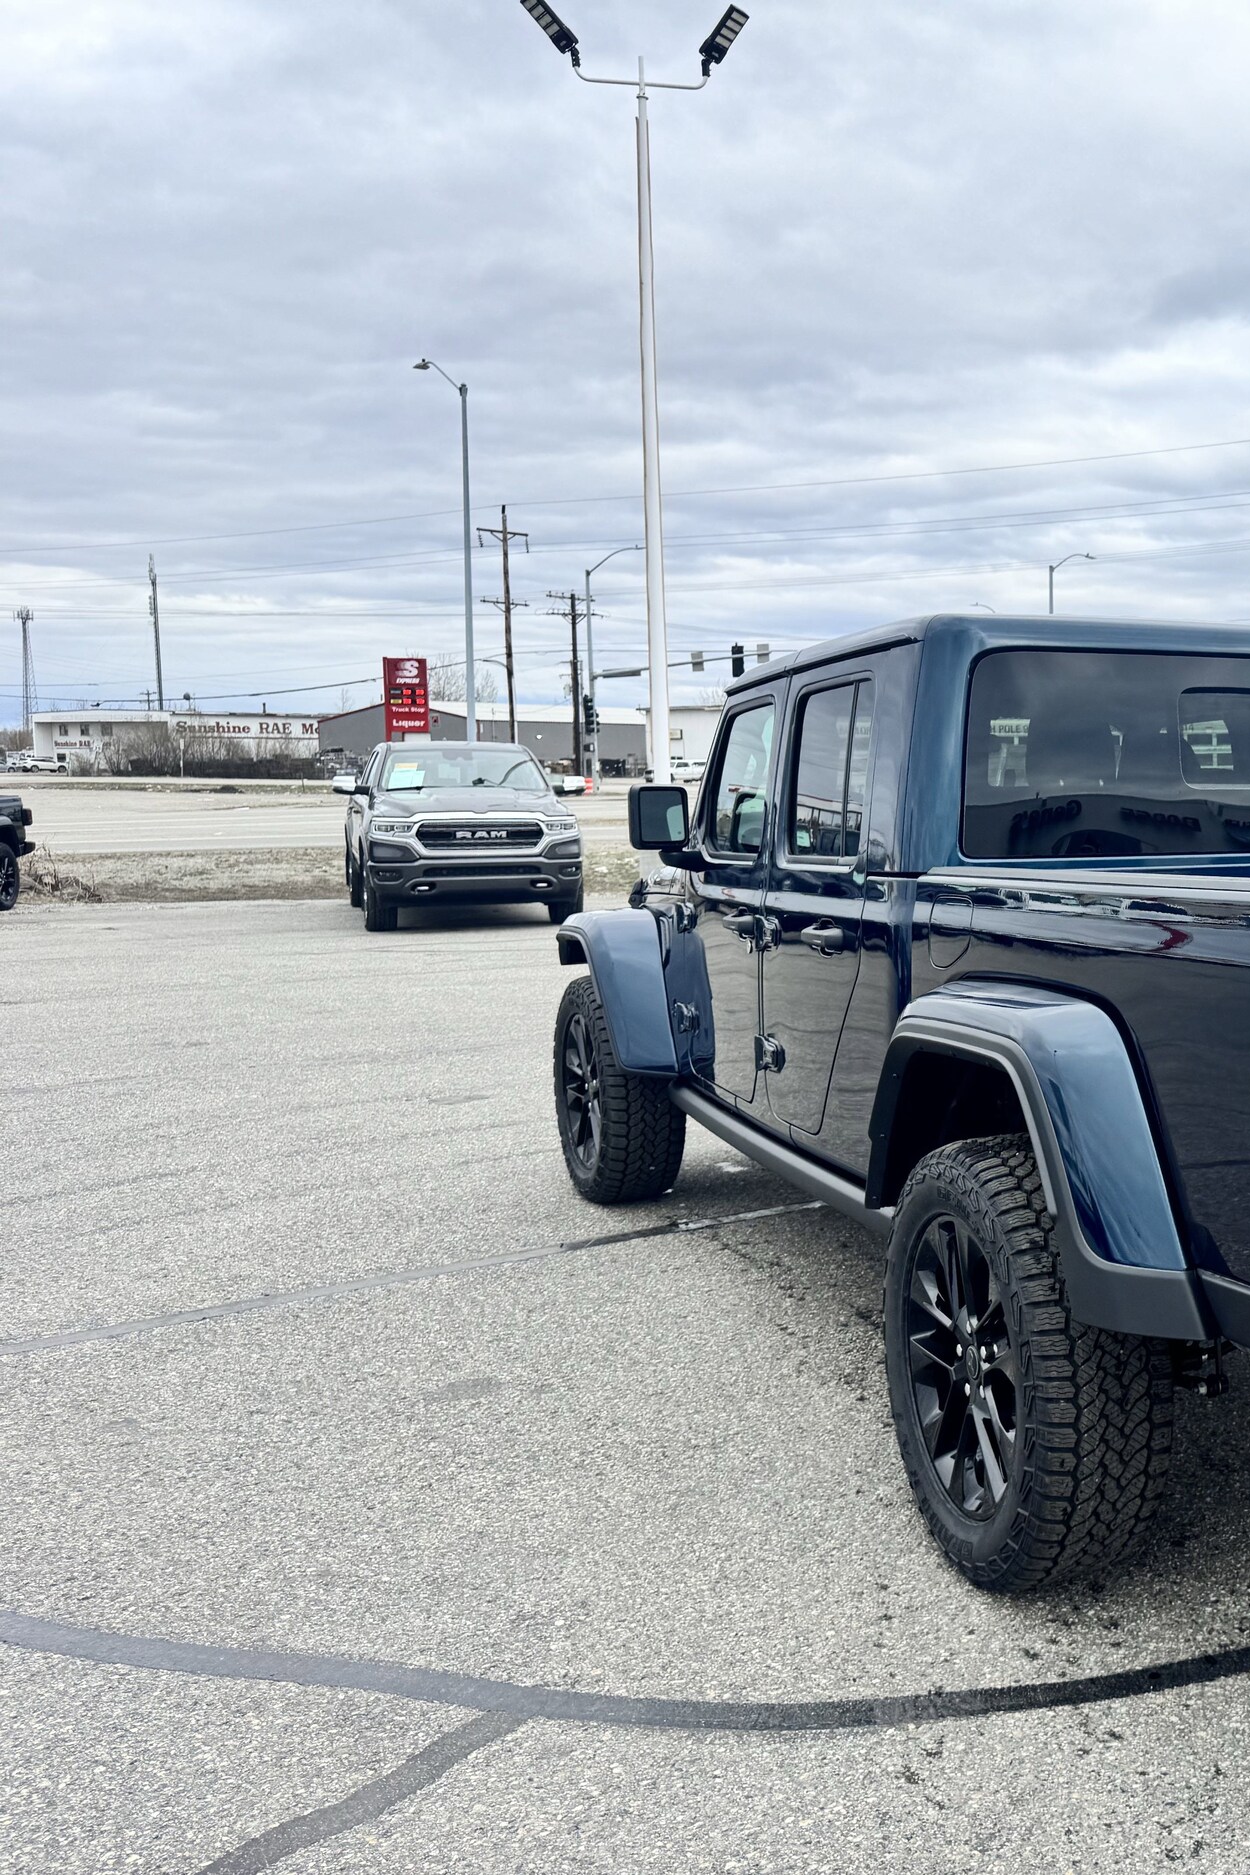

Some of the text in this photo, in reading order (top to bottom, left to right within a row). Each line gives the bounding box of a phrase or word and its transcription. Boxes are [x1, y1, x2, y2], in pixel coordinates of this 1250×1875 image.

[175, 721, 251, 734] Sunshine
[259, 722, 292, 734] RAE
[393, 719, 425, 728] Liquor
[455, 830, 508, 839] RAM
